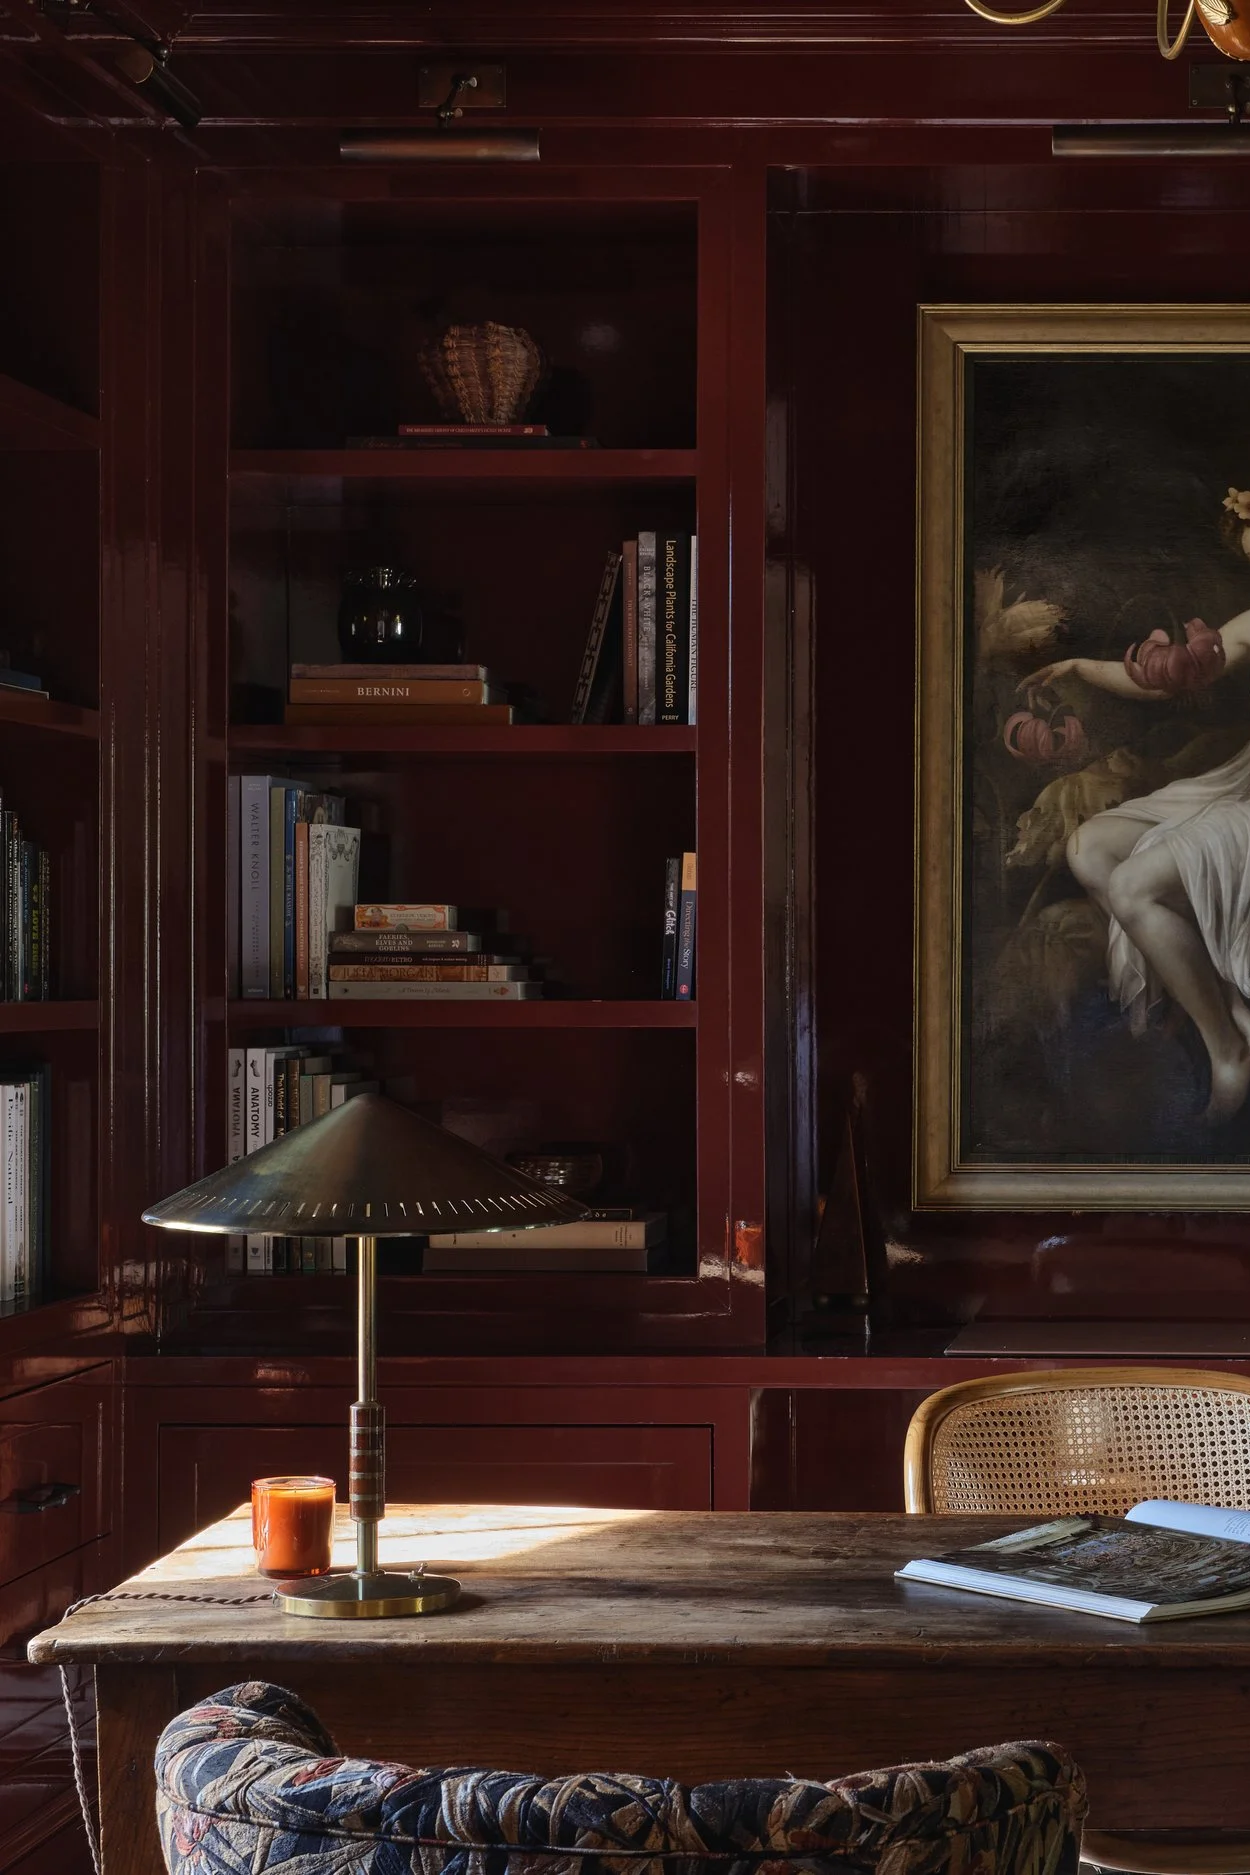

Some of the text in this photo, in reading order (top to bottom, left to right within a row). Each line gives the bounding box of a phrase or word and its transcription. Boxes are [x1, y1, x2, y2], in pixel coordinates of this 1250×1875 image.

[643, 566, 651, 632] BLACK WHITE
[664, 540, 677, 708] Landscape Plants for California Gardens
[357, 687, 410, 697] BERNINI
[250, 802, 260, 891] WALTER KNOLL
[665, 909, 676, 936] Glitch
[682, 900, 694, 938] Directing
[681, 948, 691, 969] Story
[250, 1087, 260, 1138] ANATOMY
[276, 1073, 285, 1120] The World of
